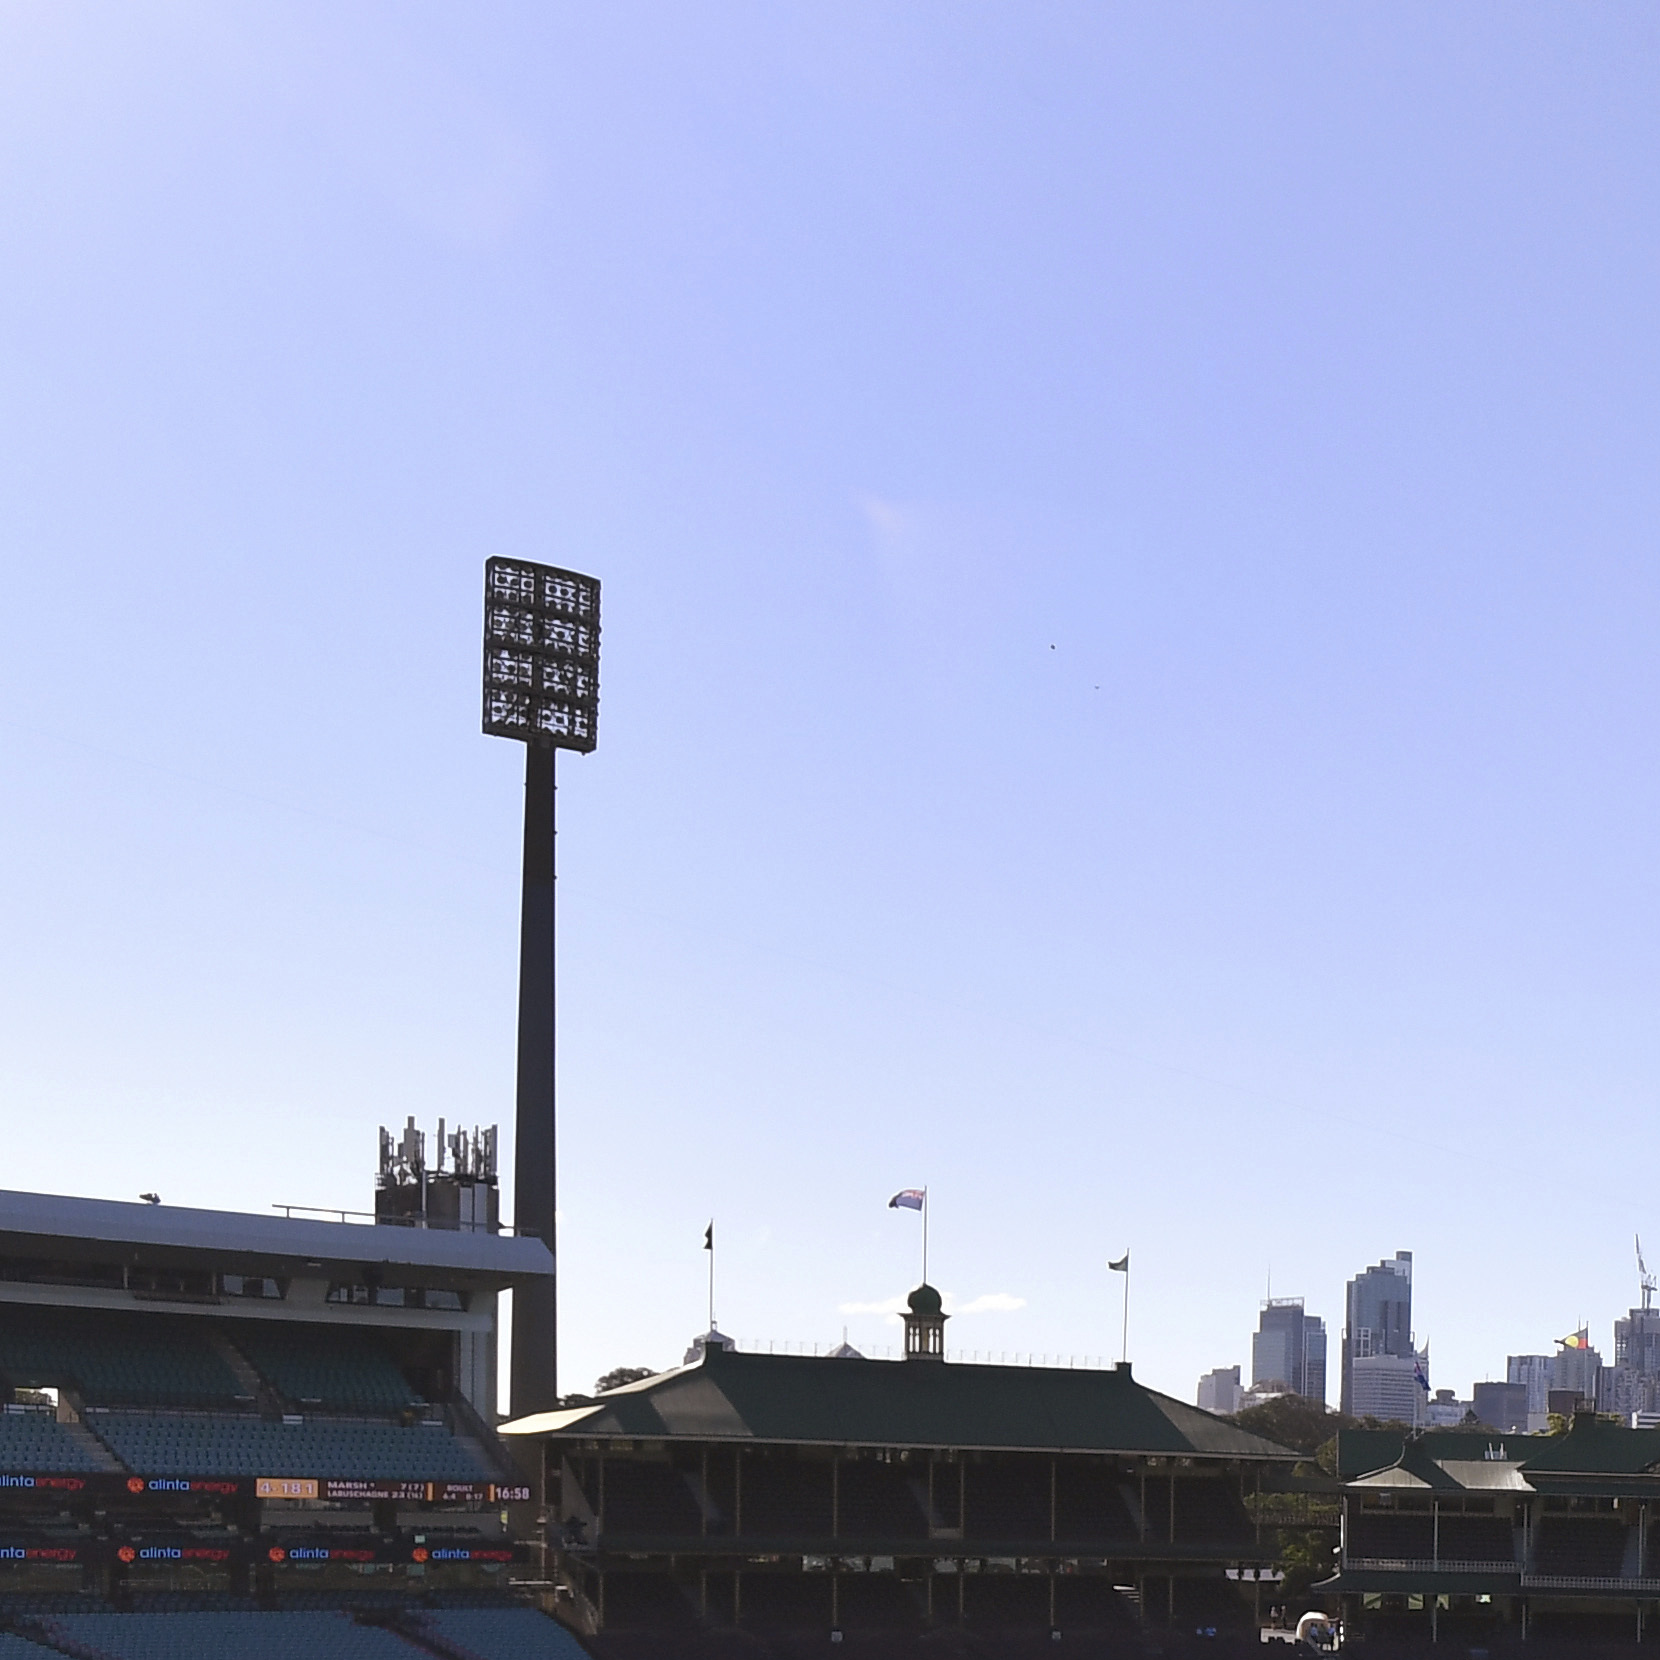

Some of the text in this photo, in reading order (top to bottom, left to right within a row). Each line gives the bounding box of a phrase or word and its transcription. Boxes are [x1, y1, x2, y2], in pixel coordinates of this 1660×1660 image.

[148, 1478, 190, 1491] alinta
[494, 1487, 530, 1500] 16:58
[139, 1547, 181, 1560] alinta
[289, 1548, 329, 1561] alinta
